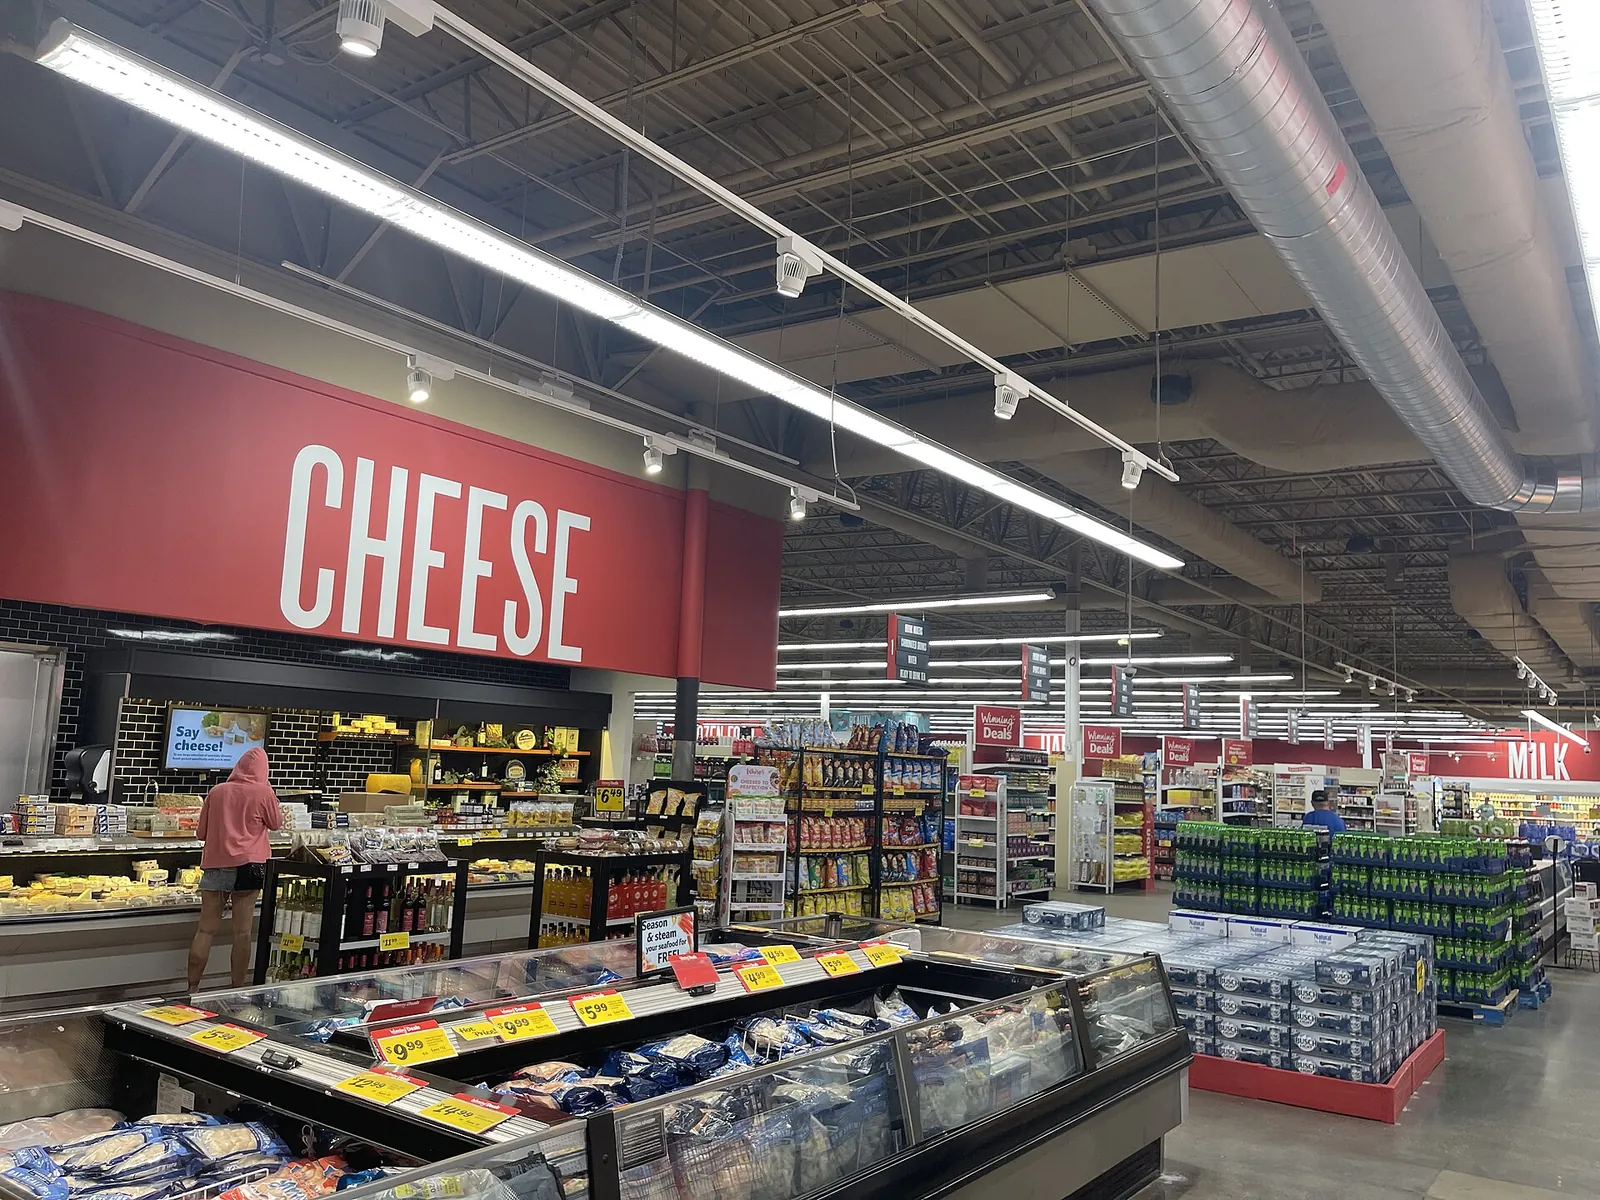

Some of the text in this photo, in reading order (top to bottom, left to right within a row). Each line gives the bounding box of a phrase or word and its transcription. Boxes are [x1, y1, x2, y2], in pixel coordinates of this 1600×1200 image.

[280, 444, 591, 663] CHEESE
[890, 639, 894, 655] 1
[981, 712, 1015, 731] Winning
[176, 726, 200, 740] Say
[983, 727, 1012, 740] Deals
[1087, 730, 1116, 746] Winning
[175, 740, 223, 751] cheese!
[1090, 743, 1114, 754] Deals
[1167, 740, 1191, 754] Winning
[1169, 752, 1189, 762] Deals
[1508, 741, 1570, 780] MILK
[642, 919, 668, 931] Season
[1189, 919, 1205, 928] Natural
[1250, 925, 1267, 935] Natural
[647, 930, 677, 942] & steam
[1313, 932, 1332, 942] Natural
[645, 938, 687, 955] your seafood for
[23, 1174, 52, 1196] SCALLPS
